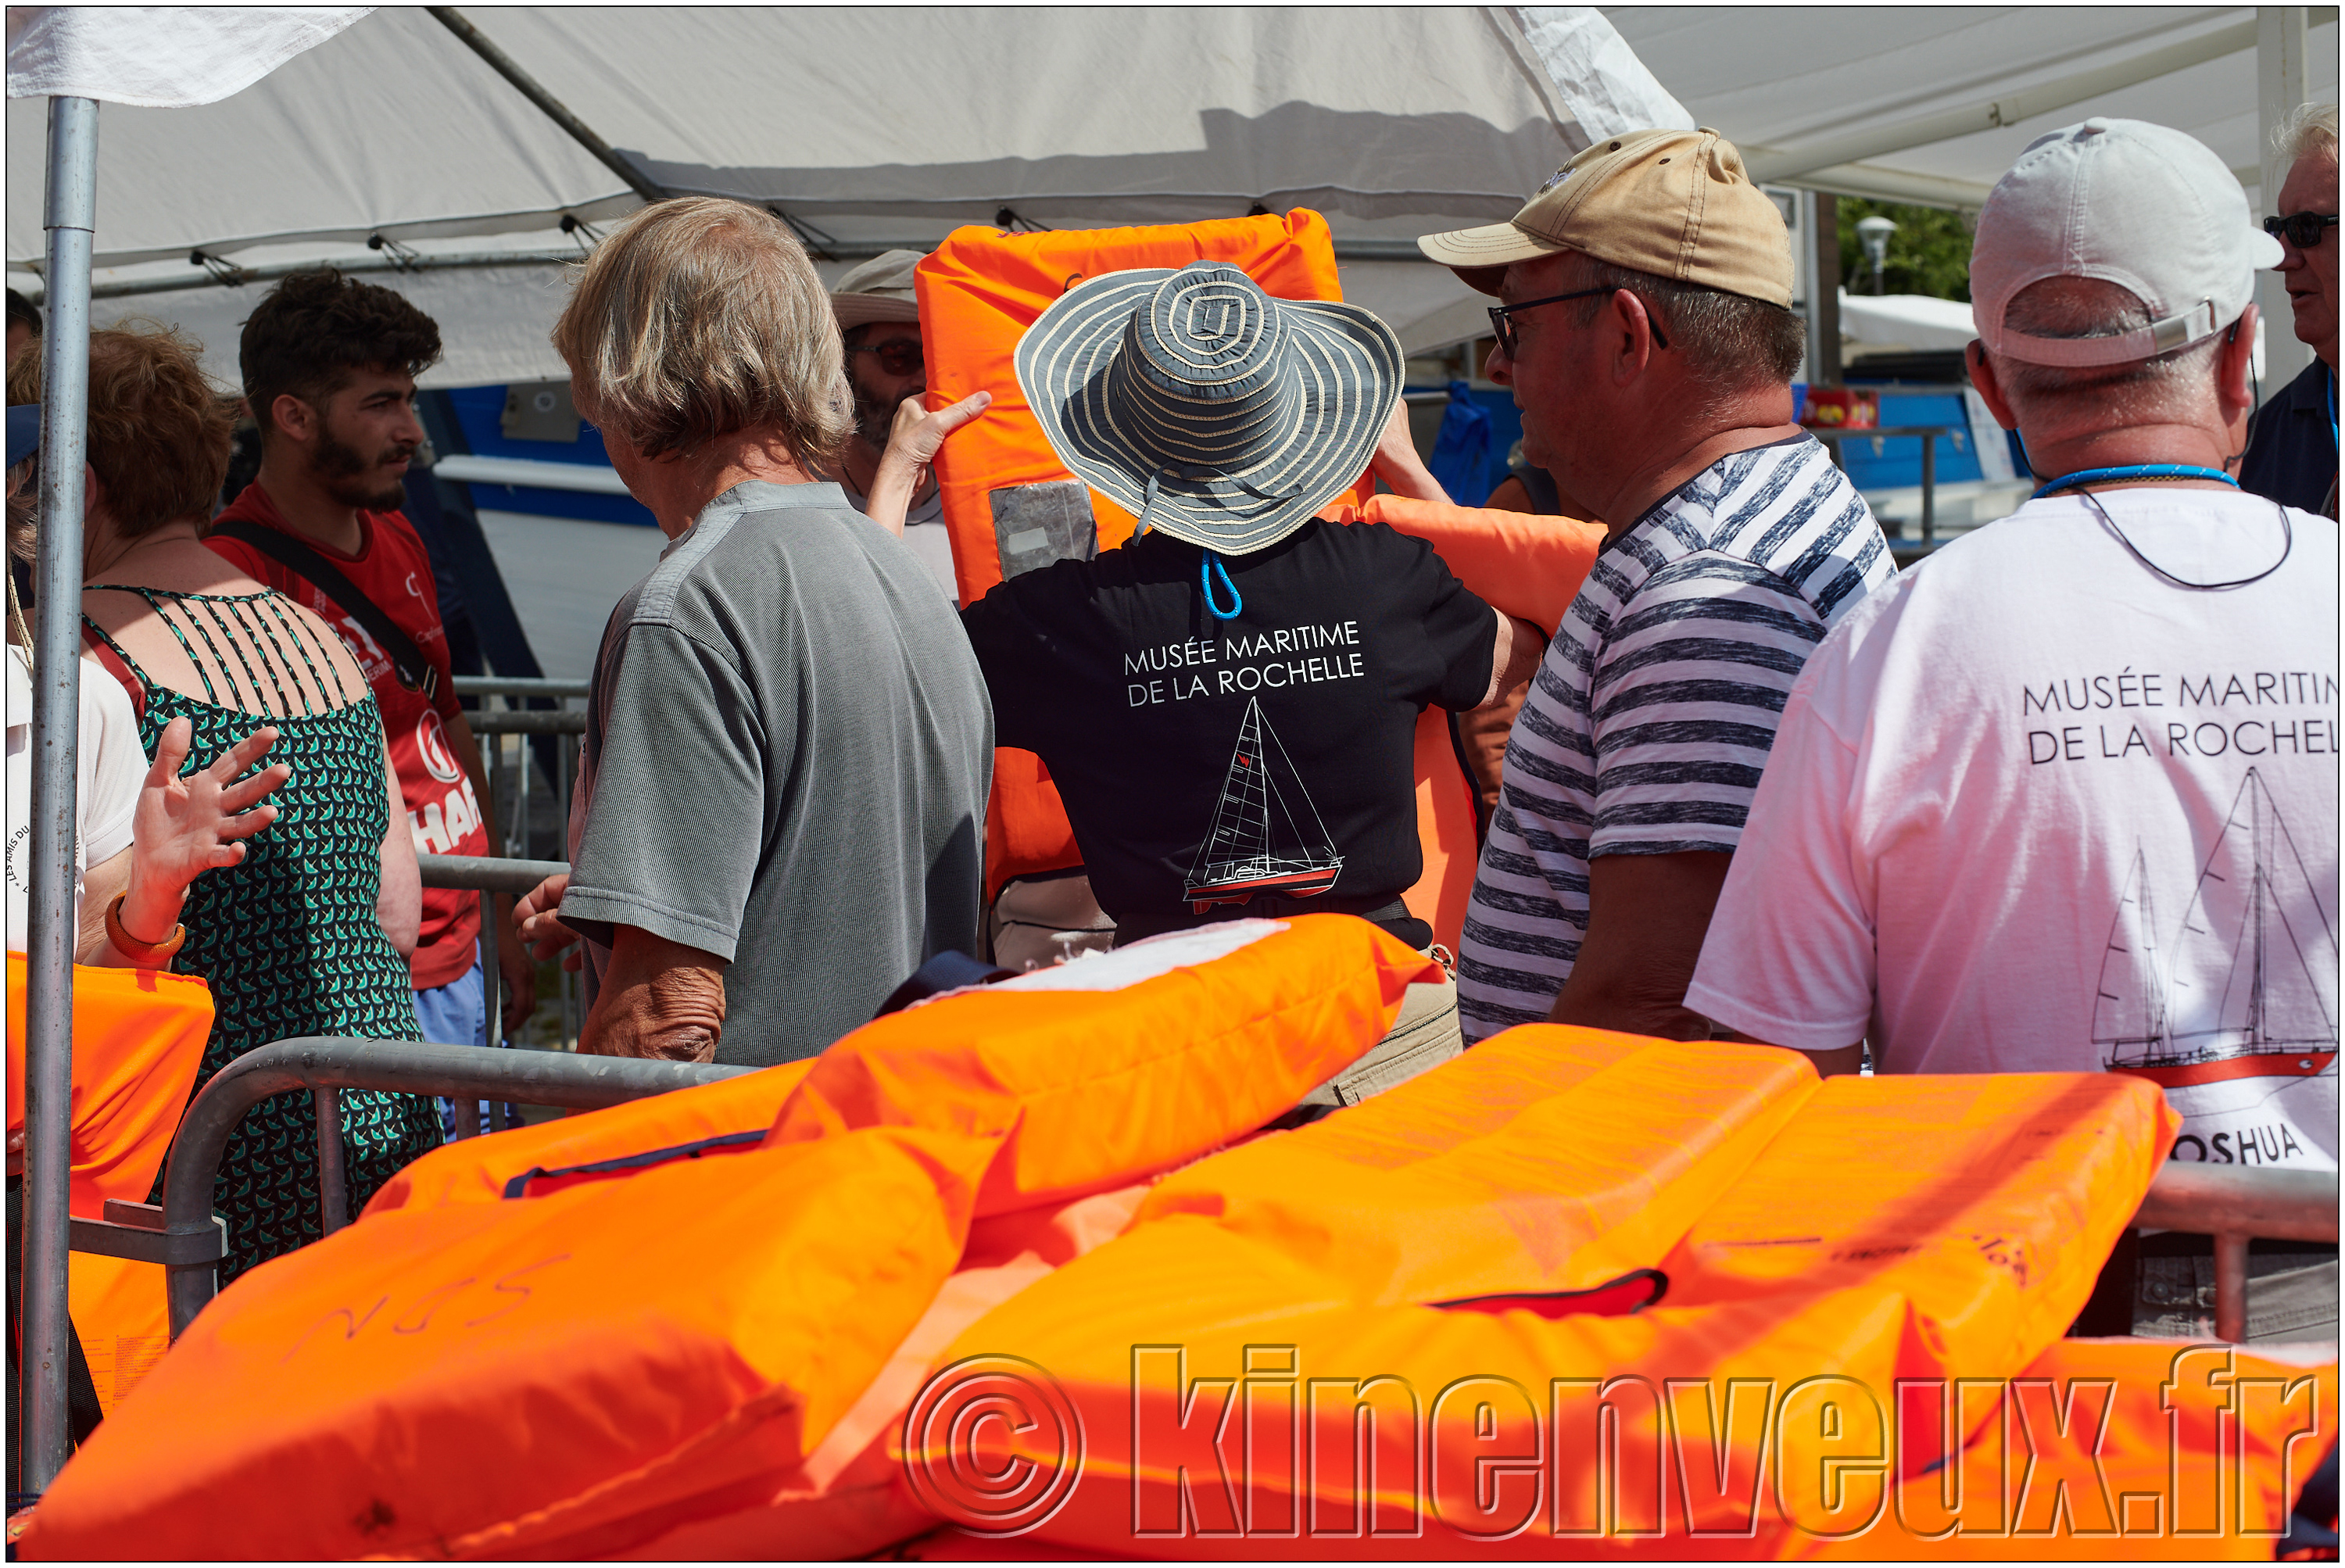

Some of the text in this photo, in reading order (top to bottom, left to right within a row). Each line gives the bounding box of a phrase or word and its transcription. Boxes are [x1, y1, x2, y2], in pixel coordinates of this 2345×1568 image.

[1125, 621, 1359, 675] MUSÉE MARITIME
[1127, 653, 1364, 707] DE LA ROCHELLE
[2023, 666, 2164, 716] MUSÉE
[2028, 725, 2085, 764] DE
[2100, 724, 2151, 758] LA
[7, 838, 18, 863] AMIS
[15, 825, 30, 839] DU
